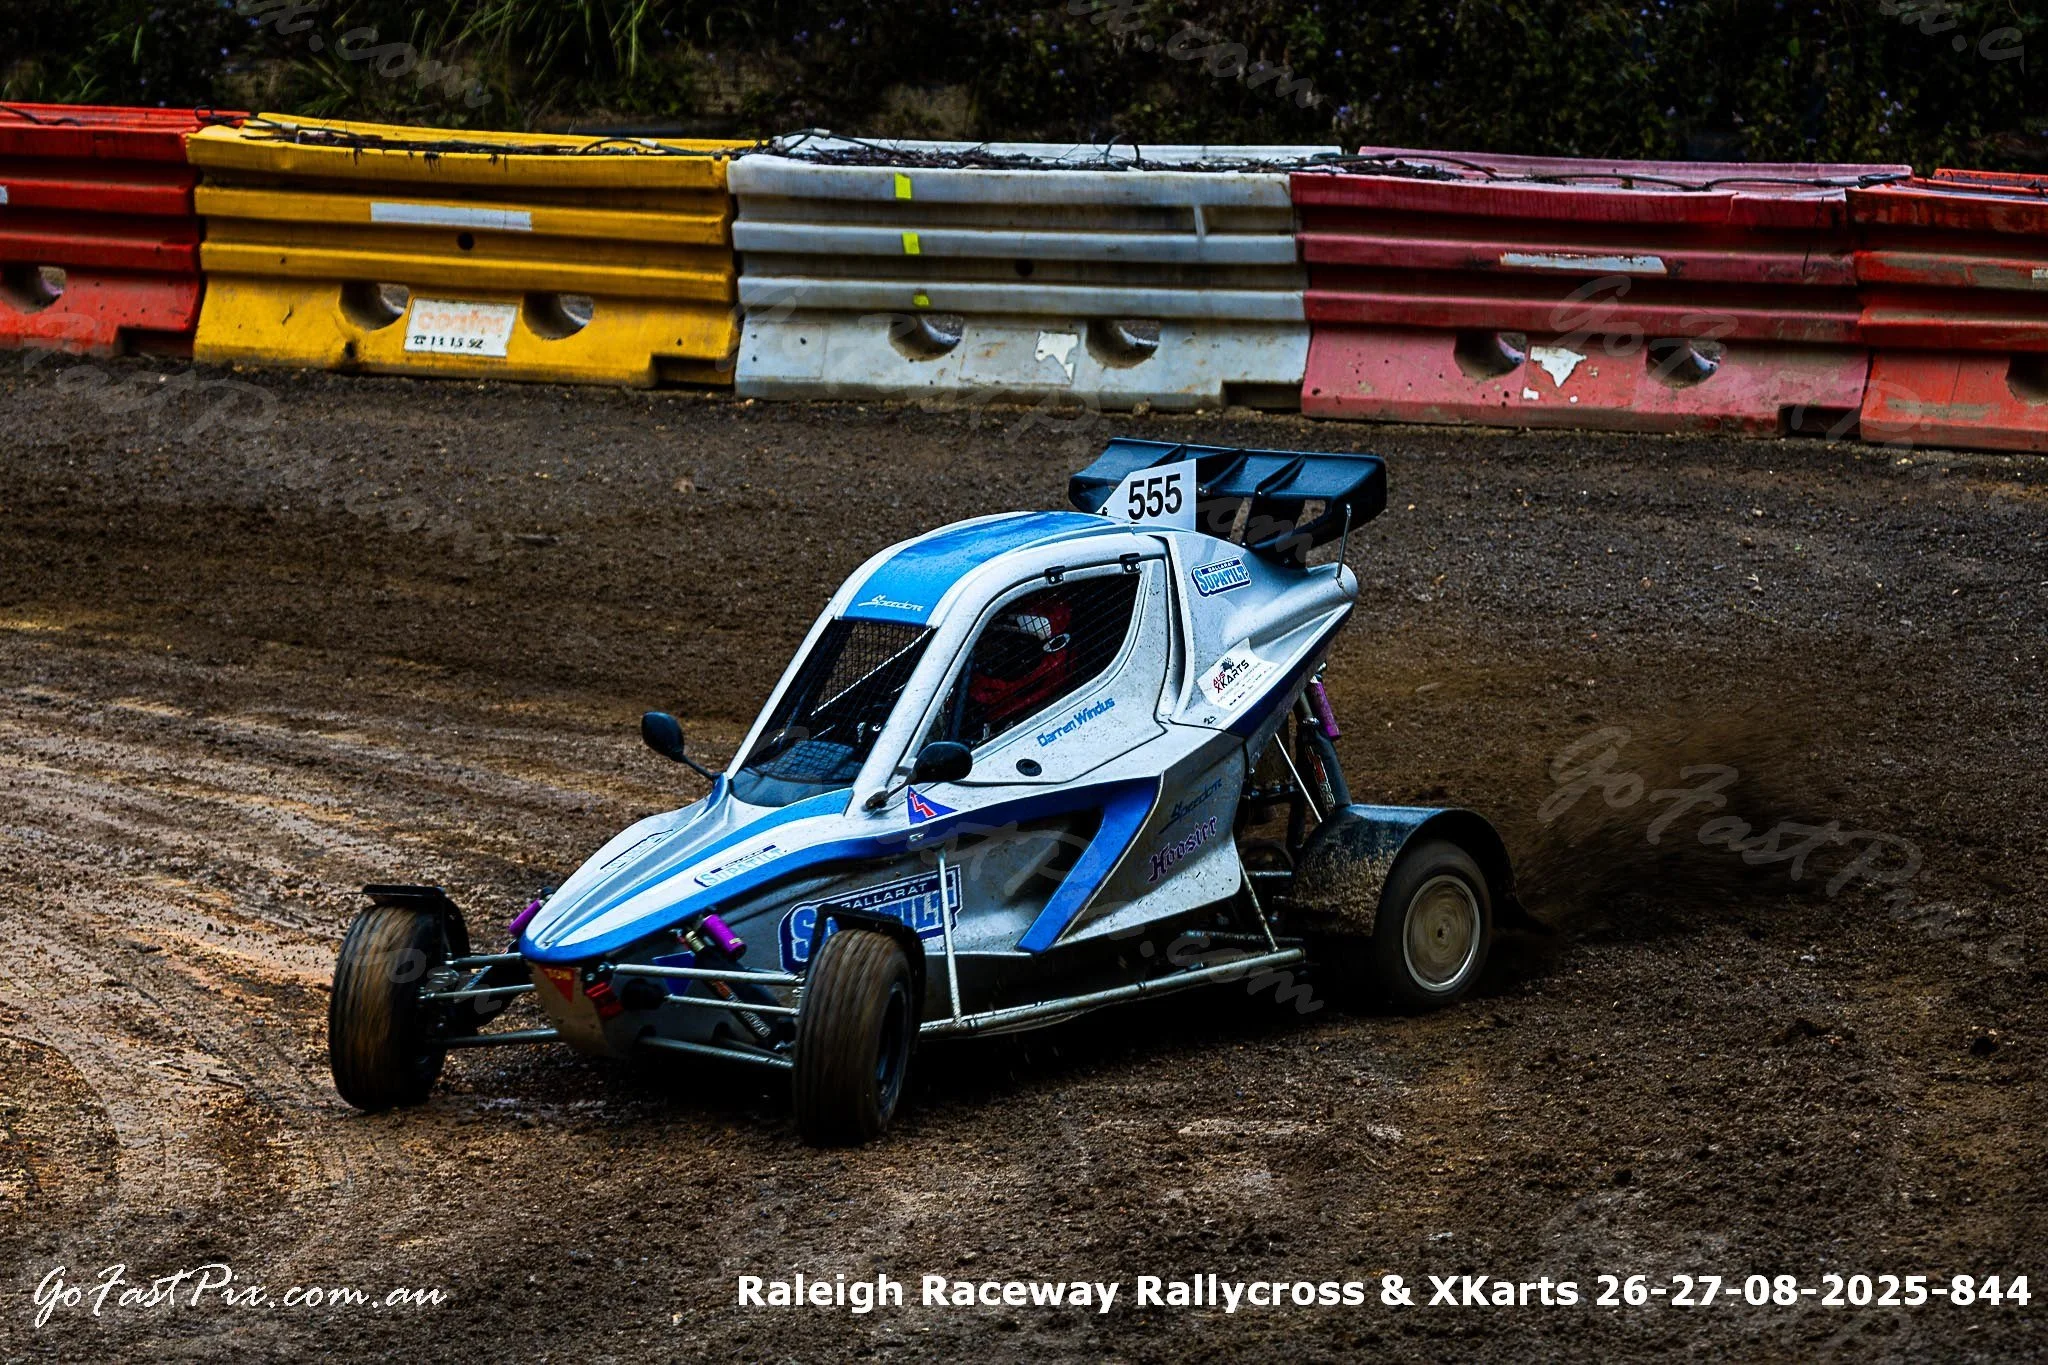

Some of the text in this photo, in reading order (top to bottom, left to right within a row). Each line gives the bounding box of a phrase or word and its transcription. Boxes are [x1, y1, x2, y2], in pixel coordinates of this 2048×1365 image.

[1127, 473, 1183, 520] 555
[1194, 564, 1249, 592] SUPATILT
[1214, 659, 1250, 693] XKARTS
[1036, 697, 1116, 747] Darren Windus
[1147, 814, 1218, 883] Hoosier
